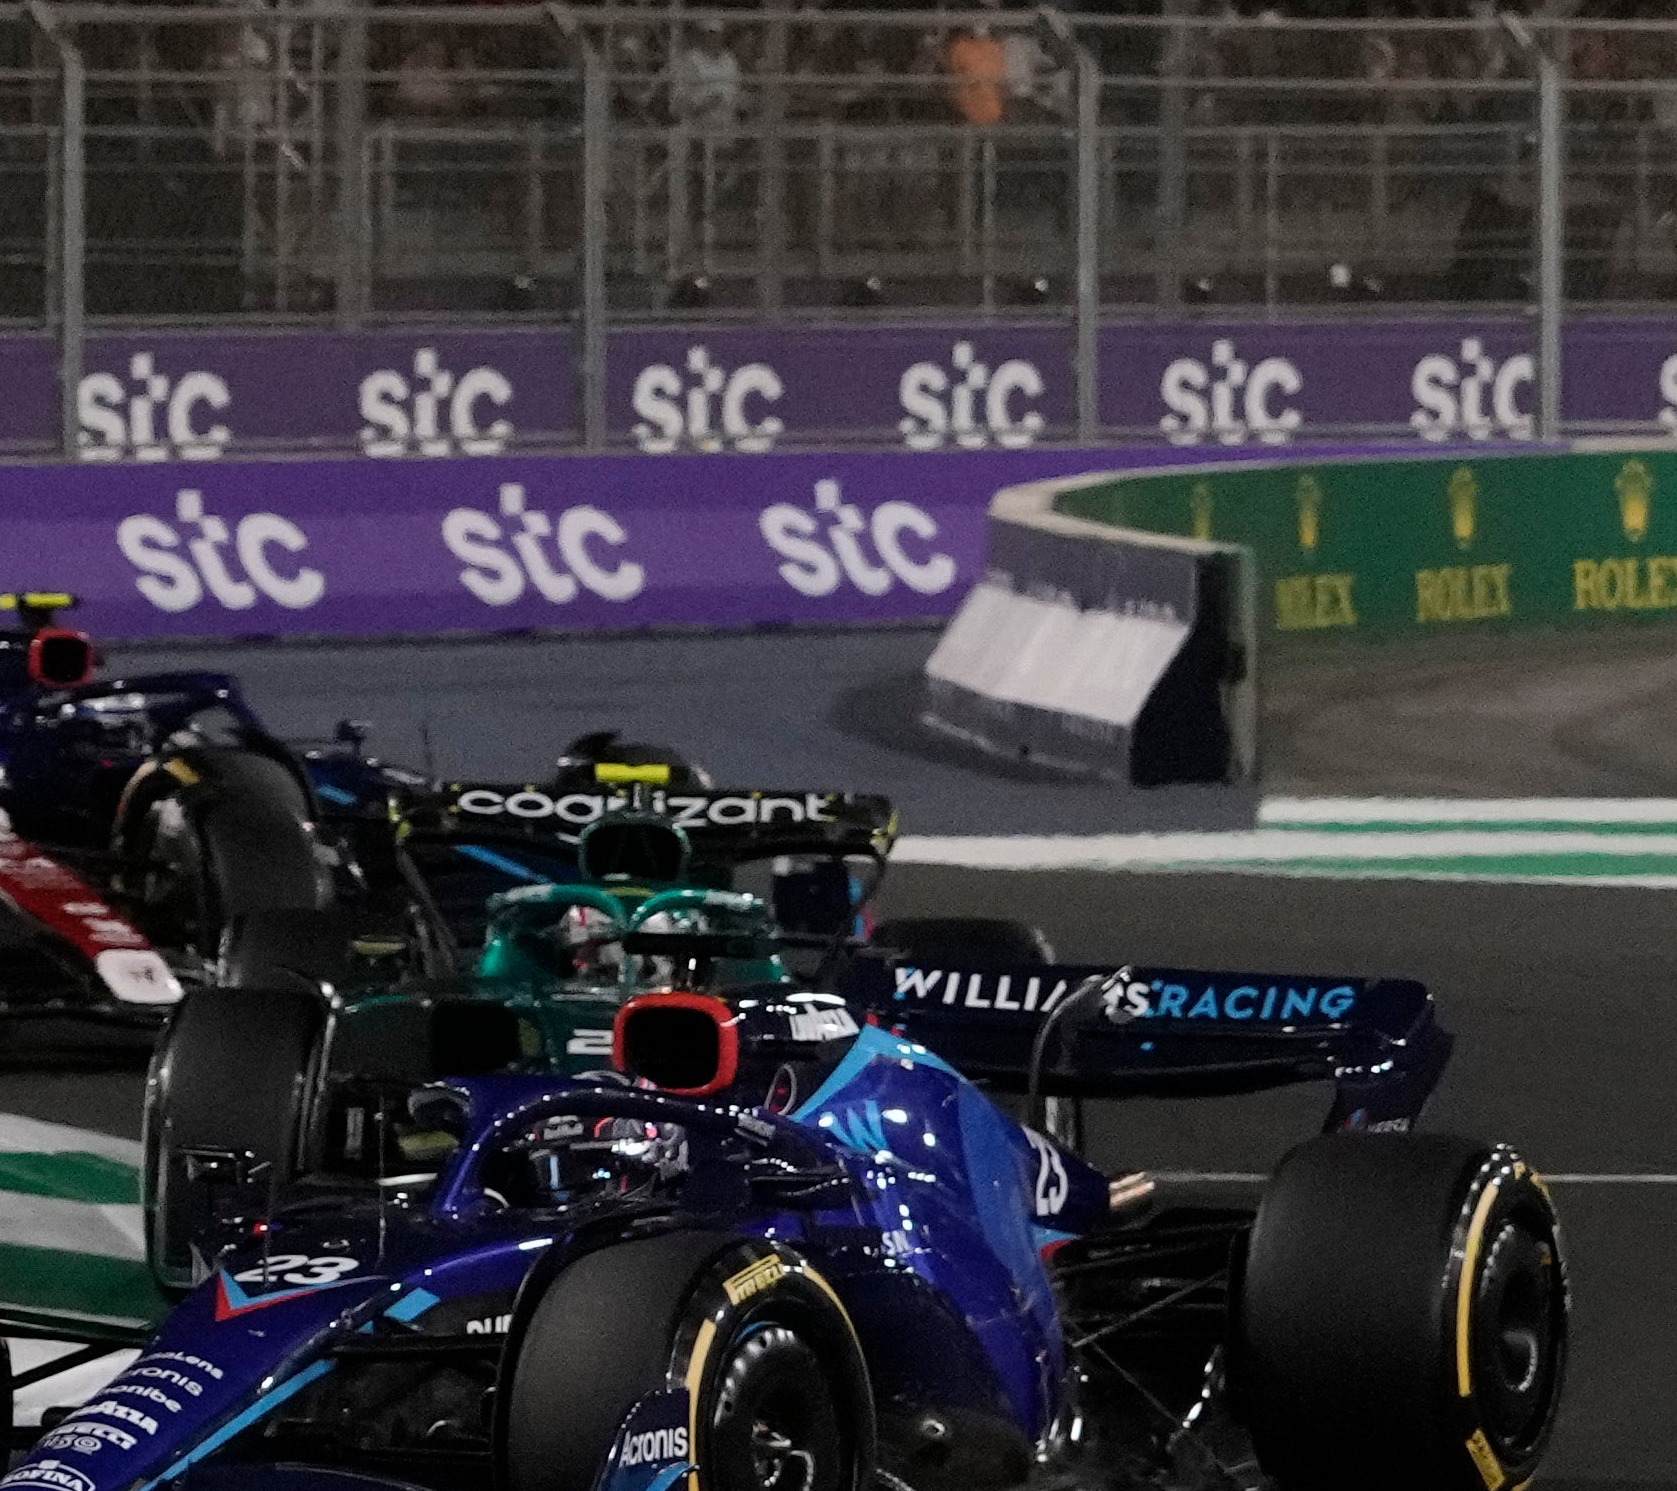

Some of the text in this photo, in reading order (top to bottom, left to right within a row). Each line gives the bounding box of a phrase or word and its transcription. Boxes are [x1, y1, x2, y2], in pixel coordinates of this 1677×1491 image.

[78, 354, 230, 463] stc
[360, 348, 518, 458] stc
[632, 347, 782, 454] stc
[899, 342, 1044, 451] stc
[1161, 339, 1303, 445] stc
[117, 490, 324, 611] stc
[442, 484, 644, 604] stc
[759, 478, 955, 599] stc
[1573, 556, 1677, 610] ROLE
[895, 965, 1357, 1022] WILLIS RACING
[233, 1253, 360, 1286] 23
[618, 1425, 690, 1469] Acronis
